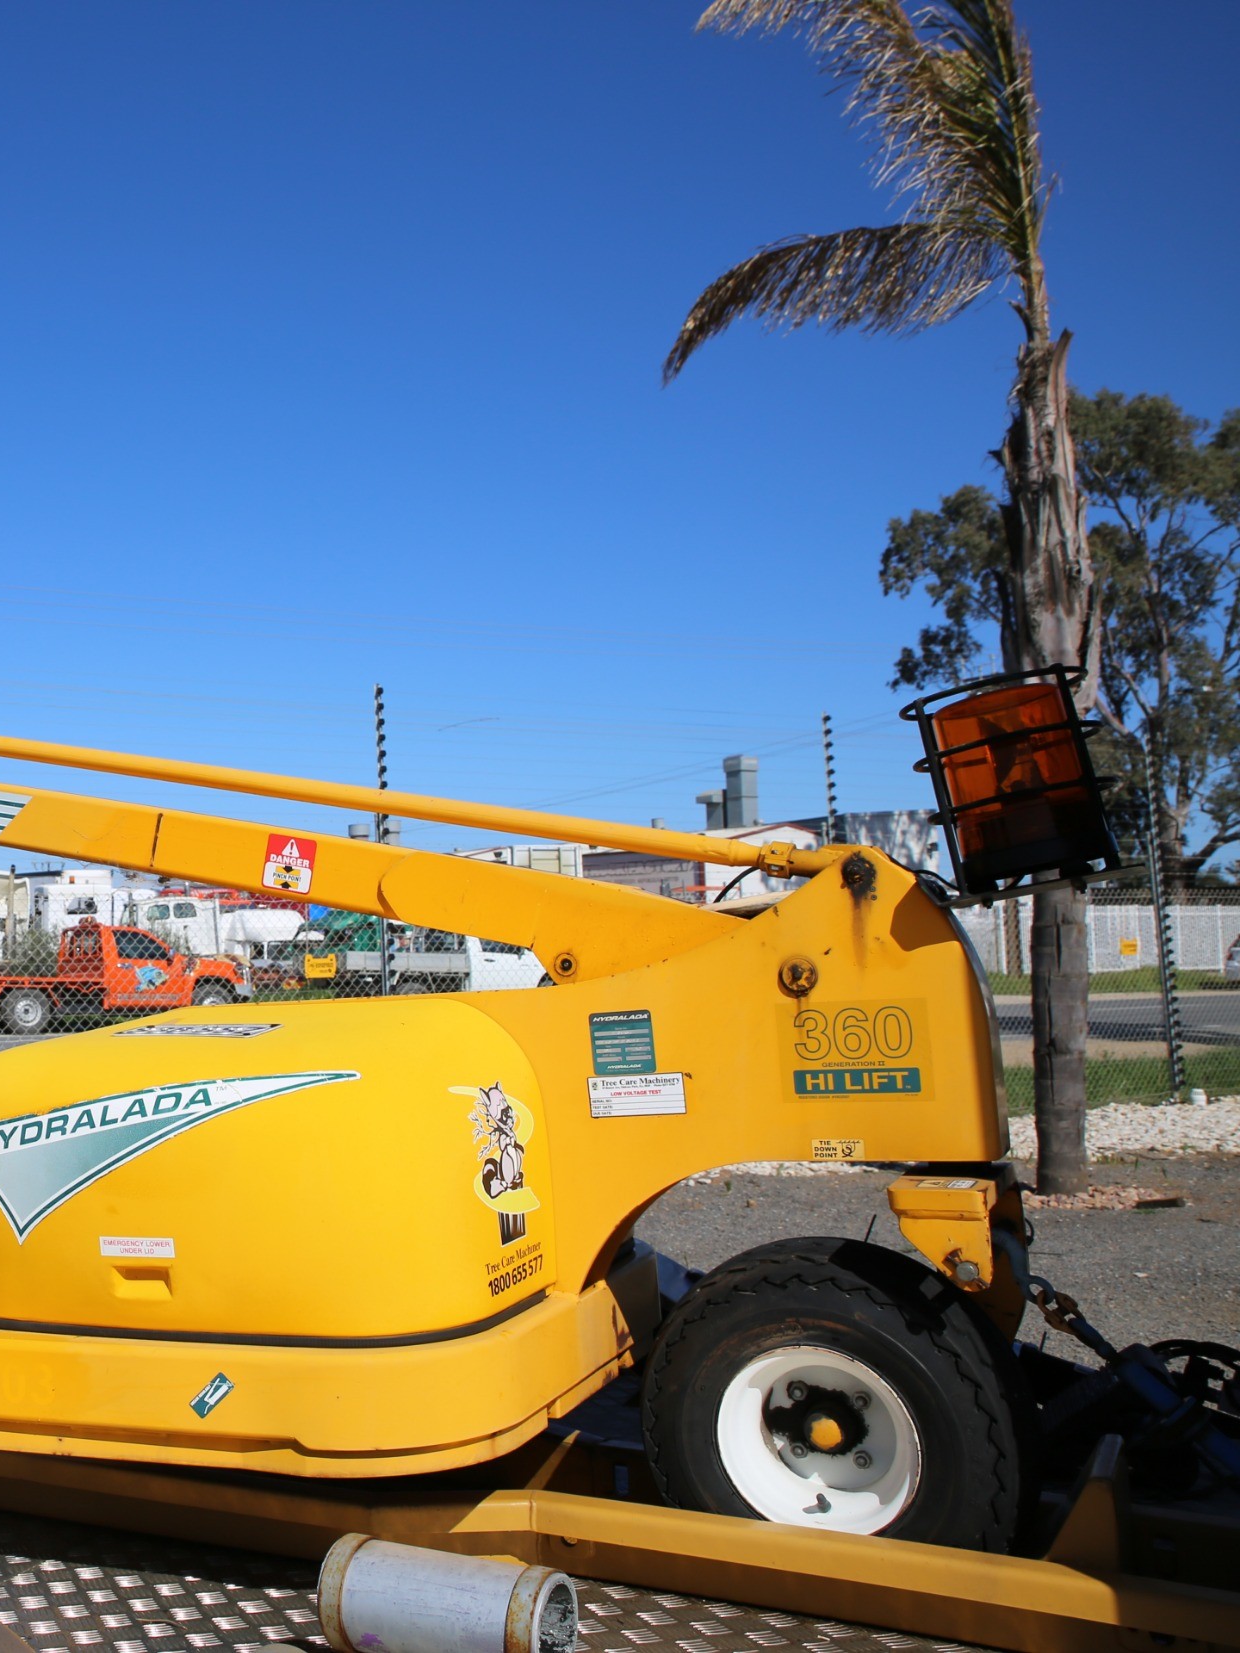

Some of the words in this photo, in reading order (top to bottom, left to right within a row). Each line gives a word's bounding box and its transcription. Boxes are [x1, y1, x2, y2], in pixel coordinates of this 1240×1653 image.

[269, 853, 310, 868] DANGER
[273, 872, 287, 880] PINCH
[287, 874, 301, 882] POINT
[592, 1013, 648, 1022] HYDRALADA
[793, 1005, 913, 1061] 360
[619, 1078, 638, 1086] Care
[639, 1076, 680, 1085] Machinery
[805, 1073, 835, 1091] HI
[844, 1071, 909, 1090] LIFT
[103, 1239, 144, 1247] EMERGENCY
[145, 1240, 171, 1248] LOWER
[485, 1262, 500, 1275] Tree
[501, 1255, 515, 1268] Care
[488, 1271, 511, 1297] 1800
[511, 1262, 528, 1286] 655
[528, 1253, 543, 1277] 577
